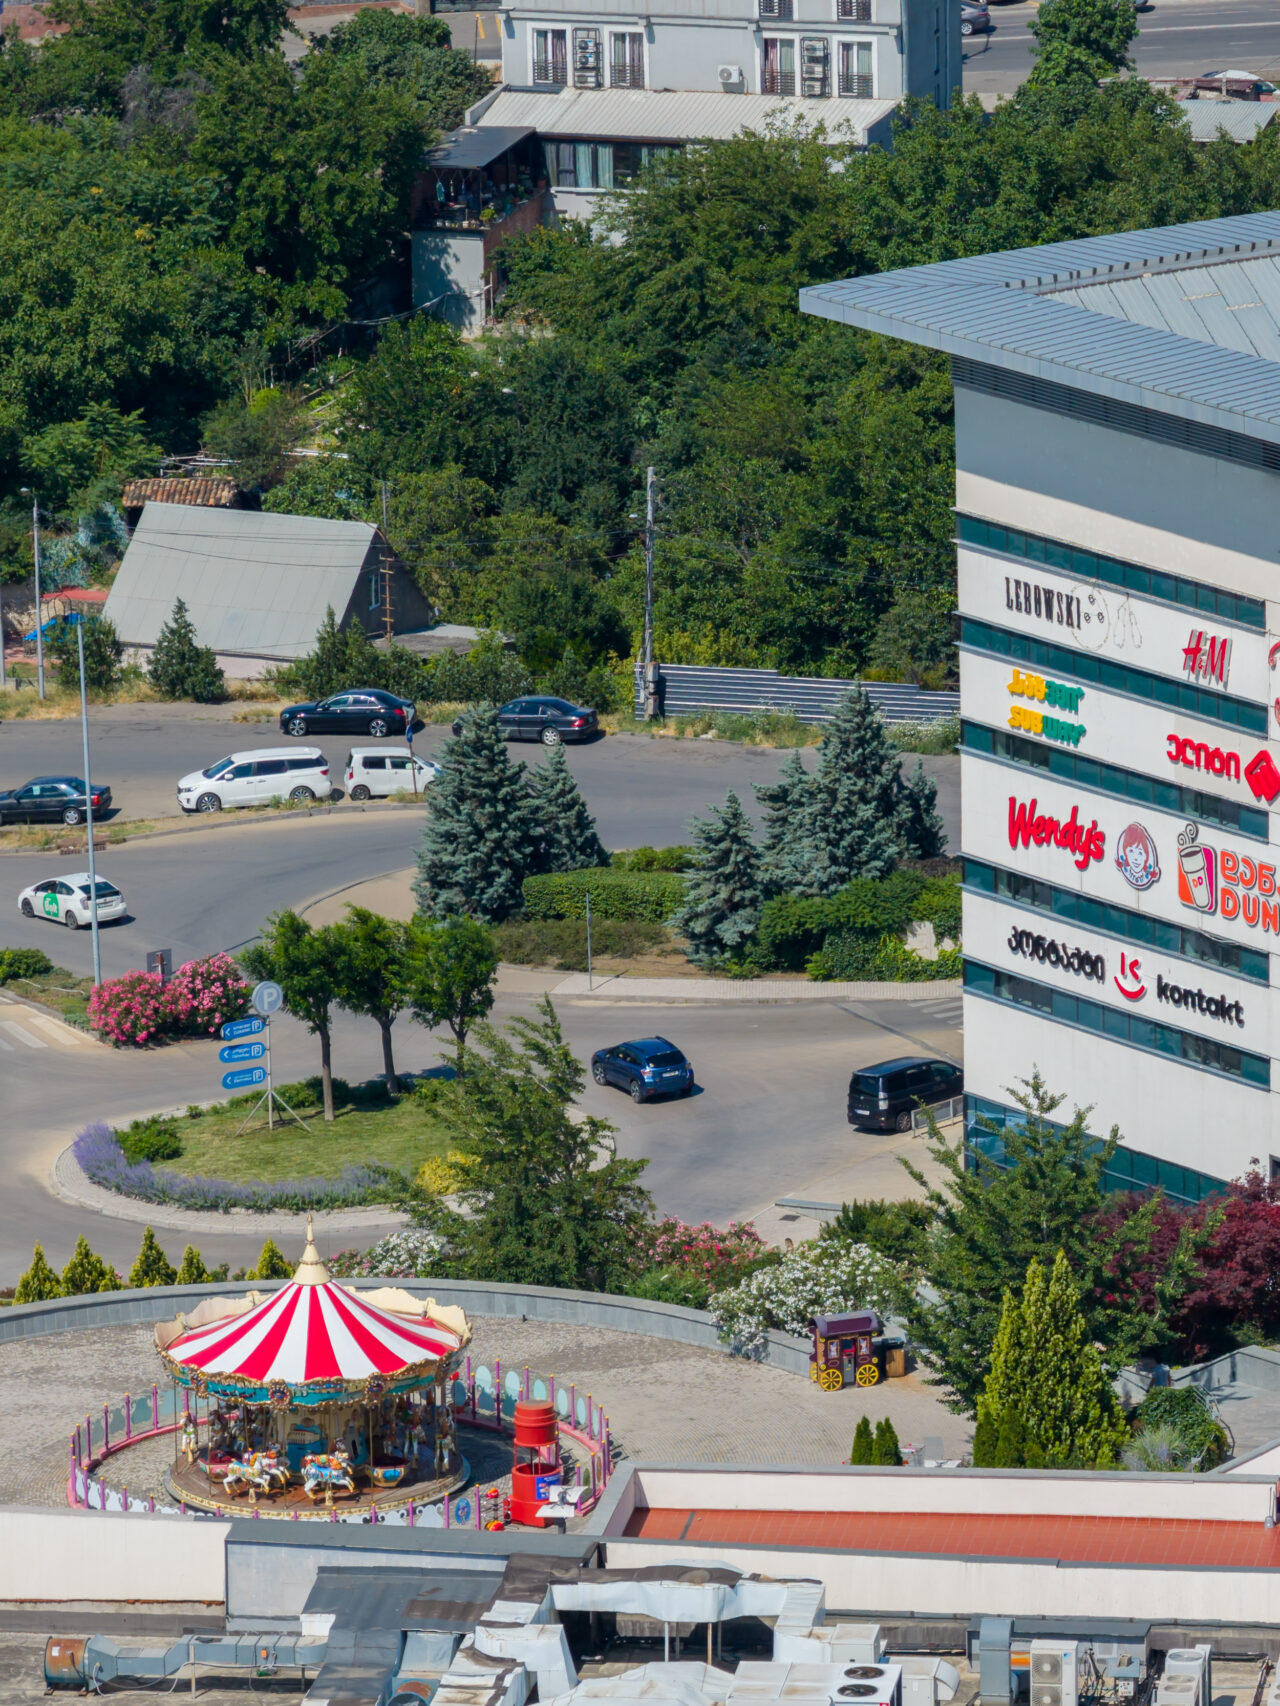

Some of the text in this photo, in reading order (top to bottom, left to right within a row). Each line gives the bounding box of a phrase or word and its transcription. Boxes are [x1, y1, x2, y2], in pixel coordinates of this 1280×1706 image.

[1005, 577, 1081, 630] LEBOWSKI
[1182, 630, 1231, 683] H&M
[1008, 706, 1087, 746] SUBWAY
[1008, 796, 1105, 870] Wendy's
[263, 987, 277, 1010] P
[1157, 974, 1244, 1026] kontakt
